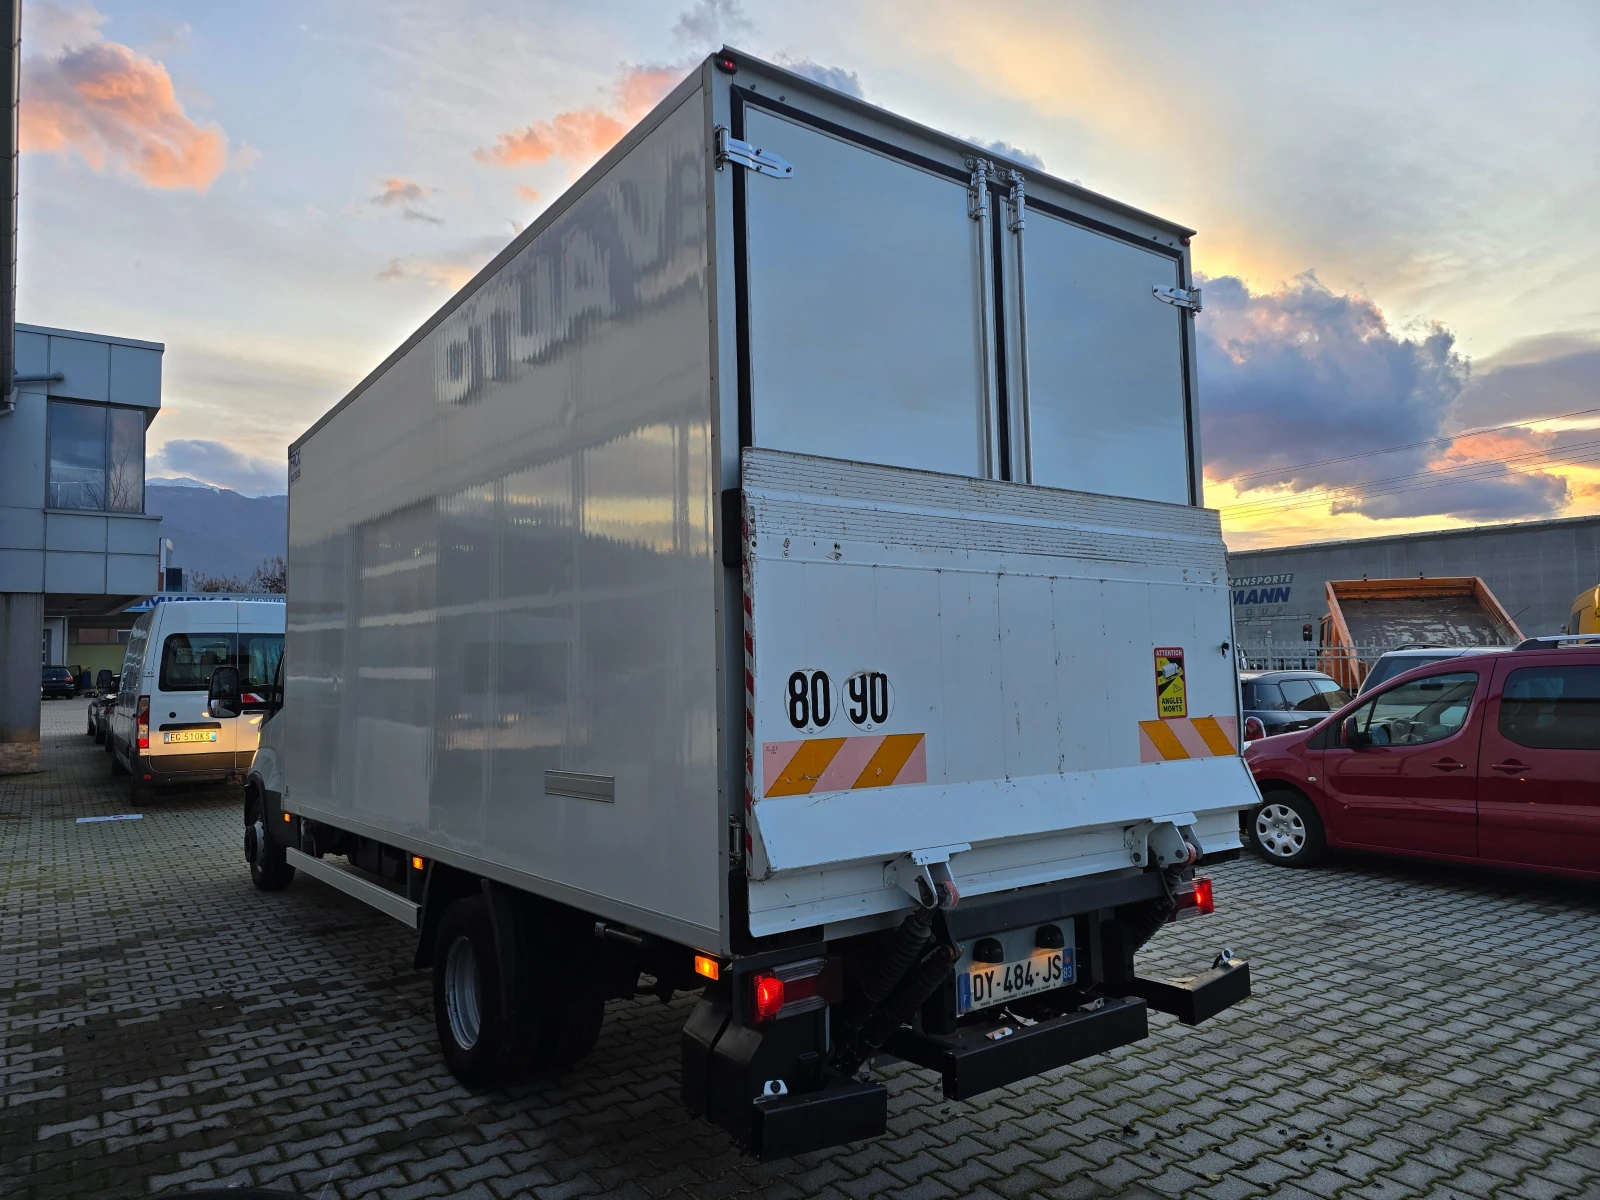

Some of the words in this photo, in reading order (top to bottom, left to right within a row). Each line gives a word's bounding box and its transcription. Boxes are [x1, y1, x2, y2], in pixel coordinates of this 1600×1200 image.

[1229, 574, 1292, 587] RANSPORTE
[1233, 586, 1291, 606] MANN
[1156, 649, 1183, 657] ATTENTION
[788, 670, 831, 729] 80
[848, 672, 889, 725] 90
[1161, 696, 1183, 705] ANGLES
[1163, 704, 1183, 713] MORTS
[170, 733, 181, 742] EG
[972, 954, 1062, 1003] DY-484-JS
[1063, 965, 1073, 979] 83
